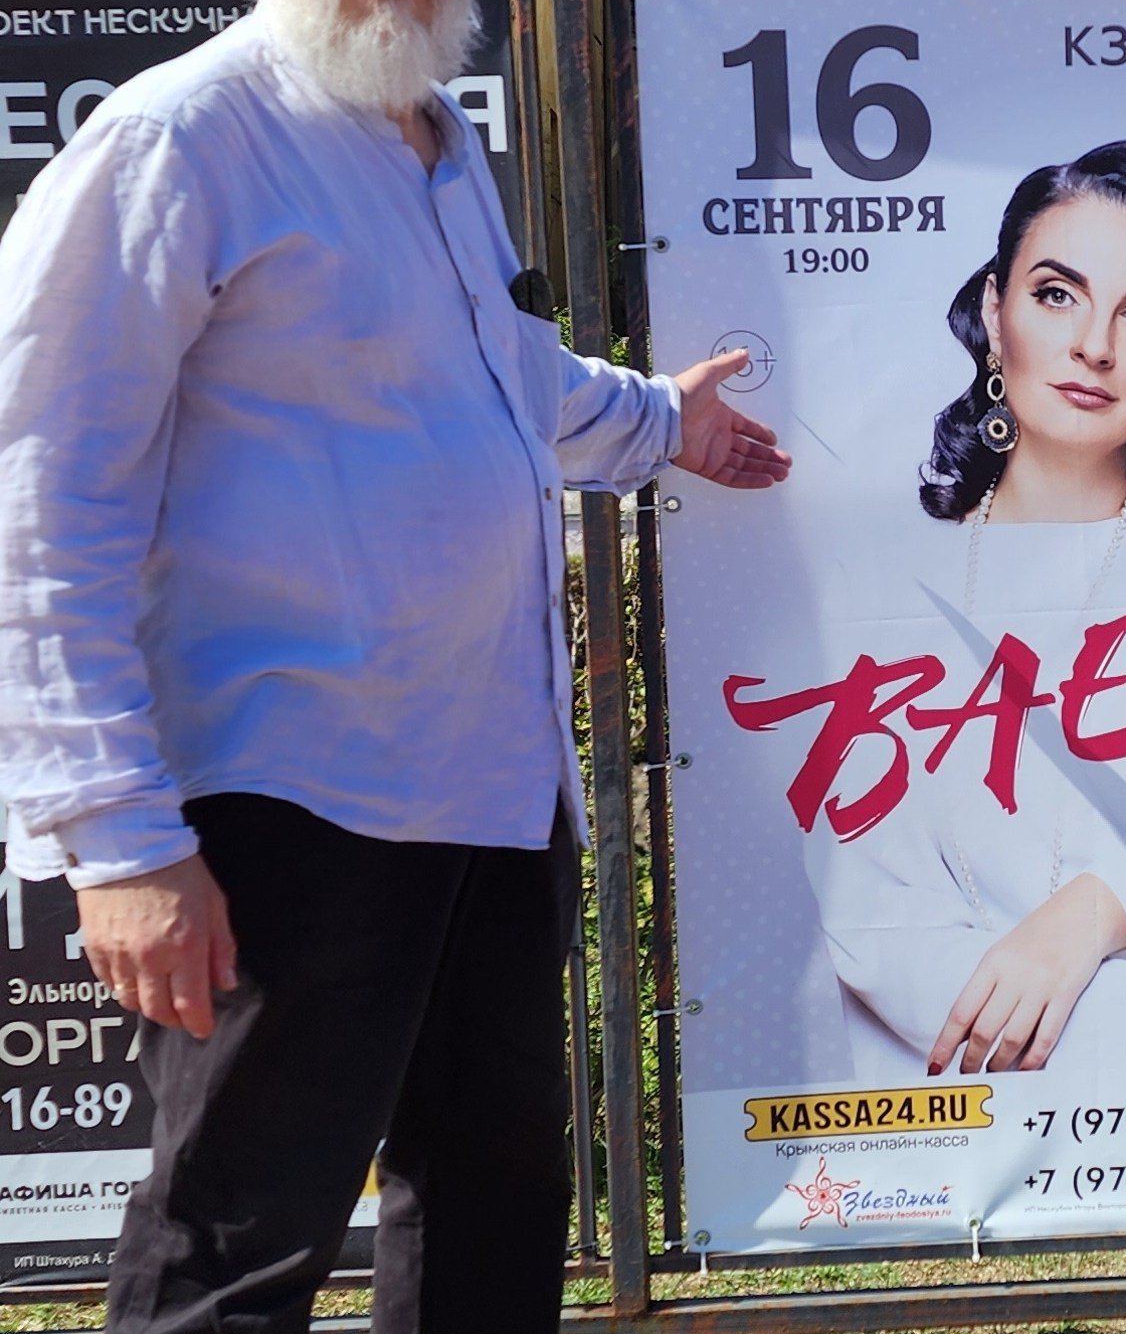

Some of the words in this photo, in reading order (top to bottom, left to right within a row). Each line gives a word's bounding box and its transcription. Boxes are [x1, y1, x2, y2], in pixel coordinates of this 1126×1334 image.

[83, 6, 252, 35] НЕСКУЧН
[722, 24, 932, 182] 16
[702, 195, 946, 235] СЕНТЯБРЯ
[783, 247, 870, 274] 19:00
[1, 1082, 133, 1131] 16-89
[769, 1094, 967, 1133] KASSA24.RU
[1023, 1110, 1057, 1138] +7
[775, 1138, 856, 1159] Крымская
[860, 1134, 969, 1152] онлайн-касса
[1023, 1169, 1057, 1195] +7
[14, 1255, 34, 1269] ИП
